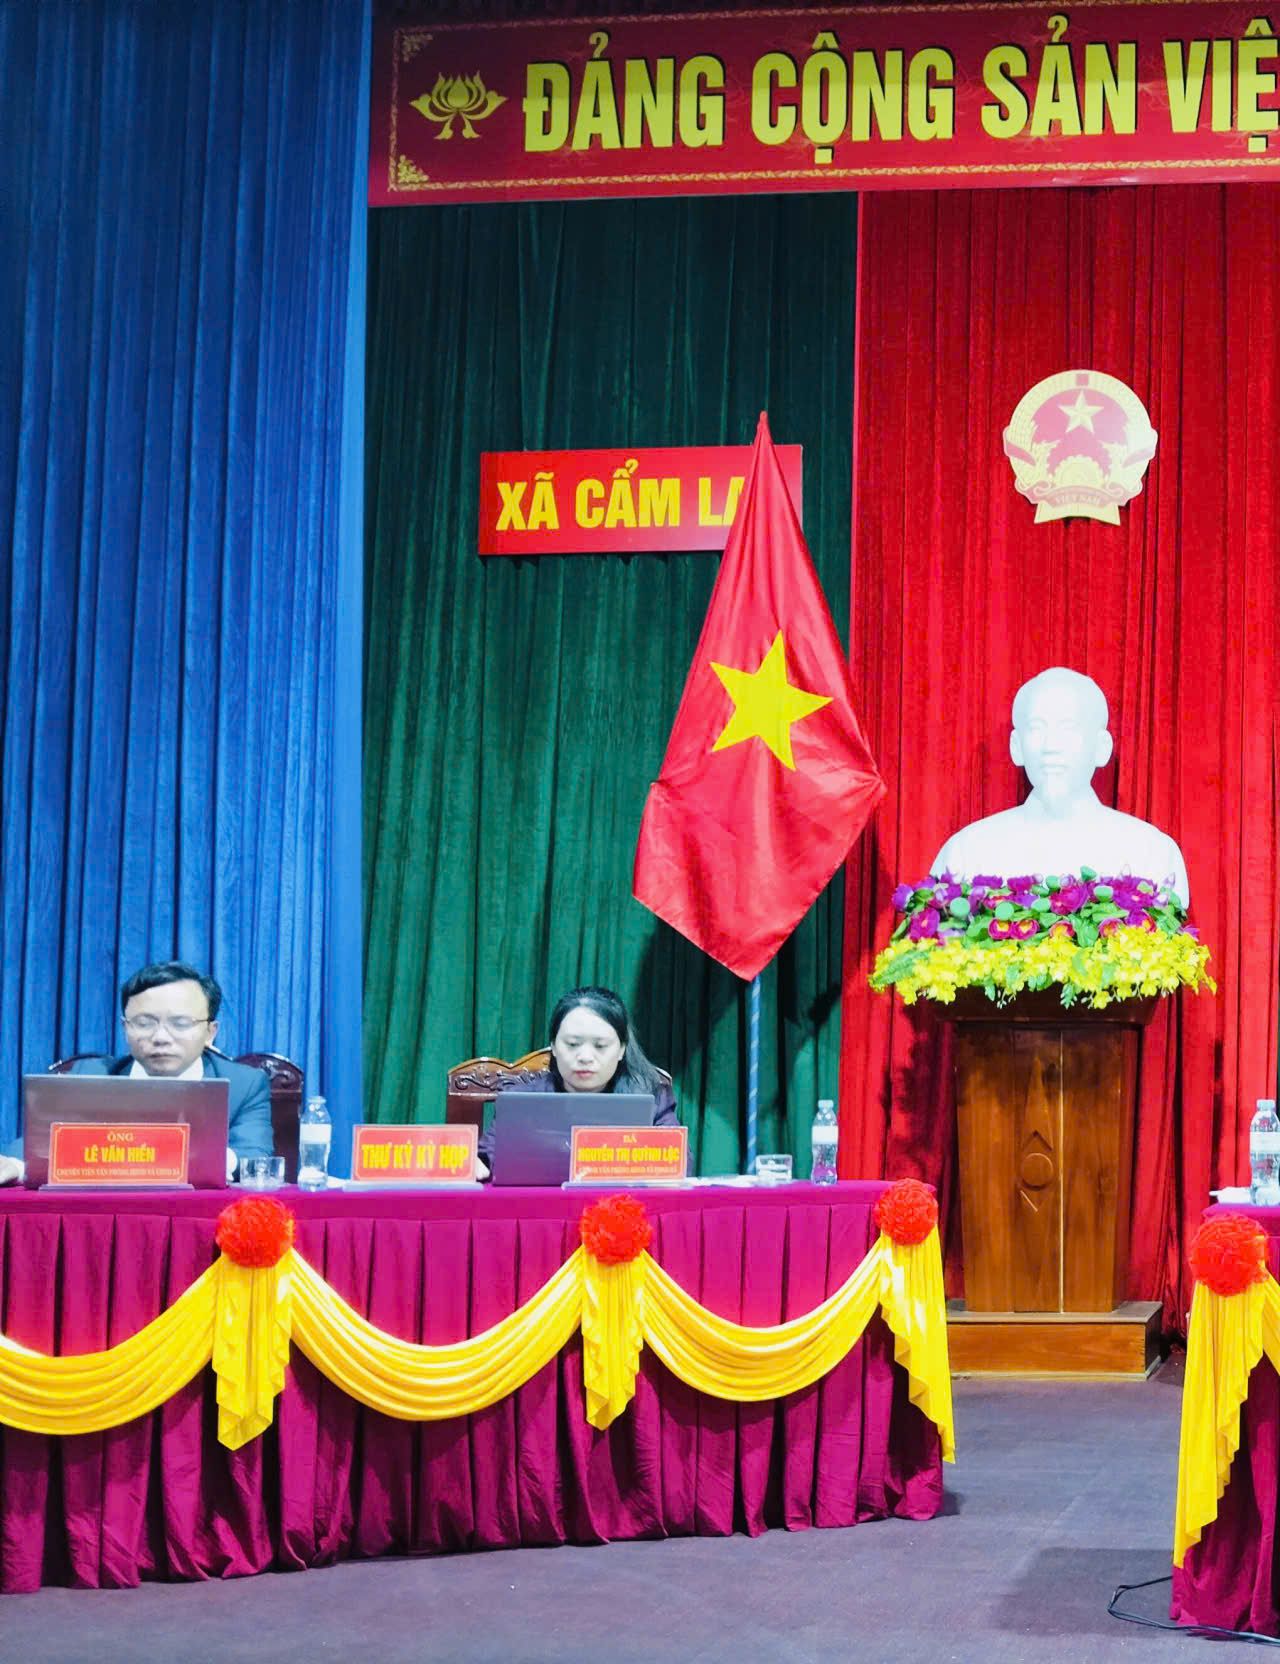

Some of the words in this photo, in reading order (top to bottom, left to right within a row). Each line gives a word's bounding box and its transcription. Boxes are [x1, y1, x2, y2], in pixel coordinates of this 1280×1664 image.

[522, 31, 726, 152] ĐẢNG
[751, 31, 954, 164] CỘNG
[980, 15, 1137, 139] SẢN
[496, 472, 559, 531] XÃ
[575, 458, 681, 528] CẨM
[84, 1144, 99, 1162] LÊ
[101, 1144, 126, 1162] VĂN
[439, 1144, 470, 1174] HỌP
